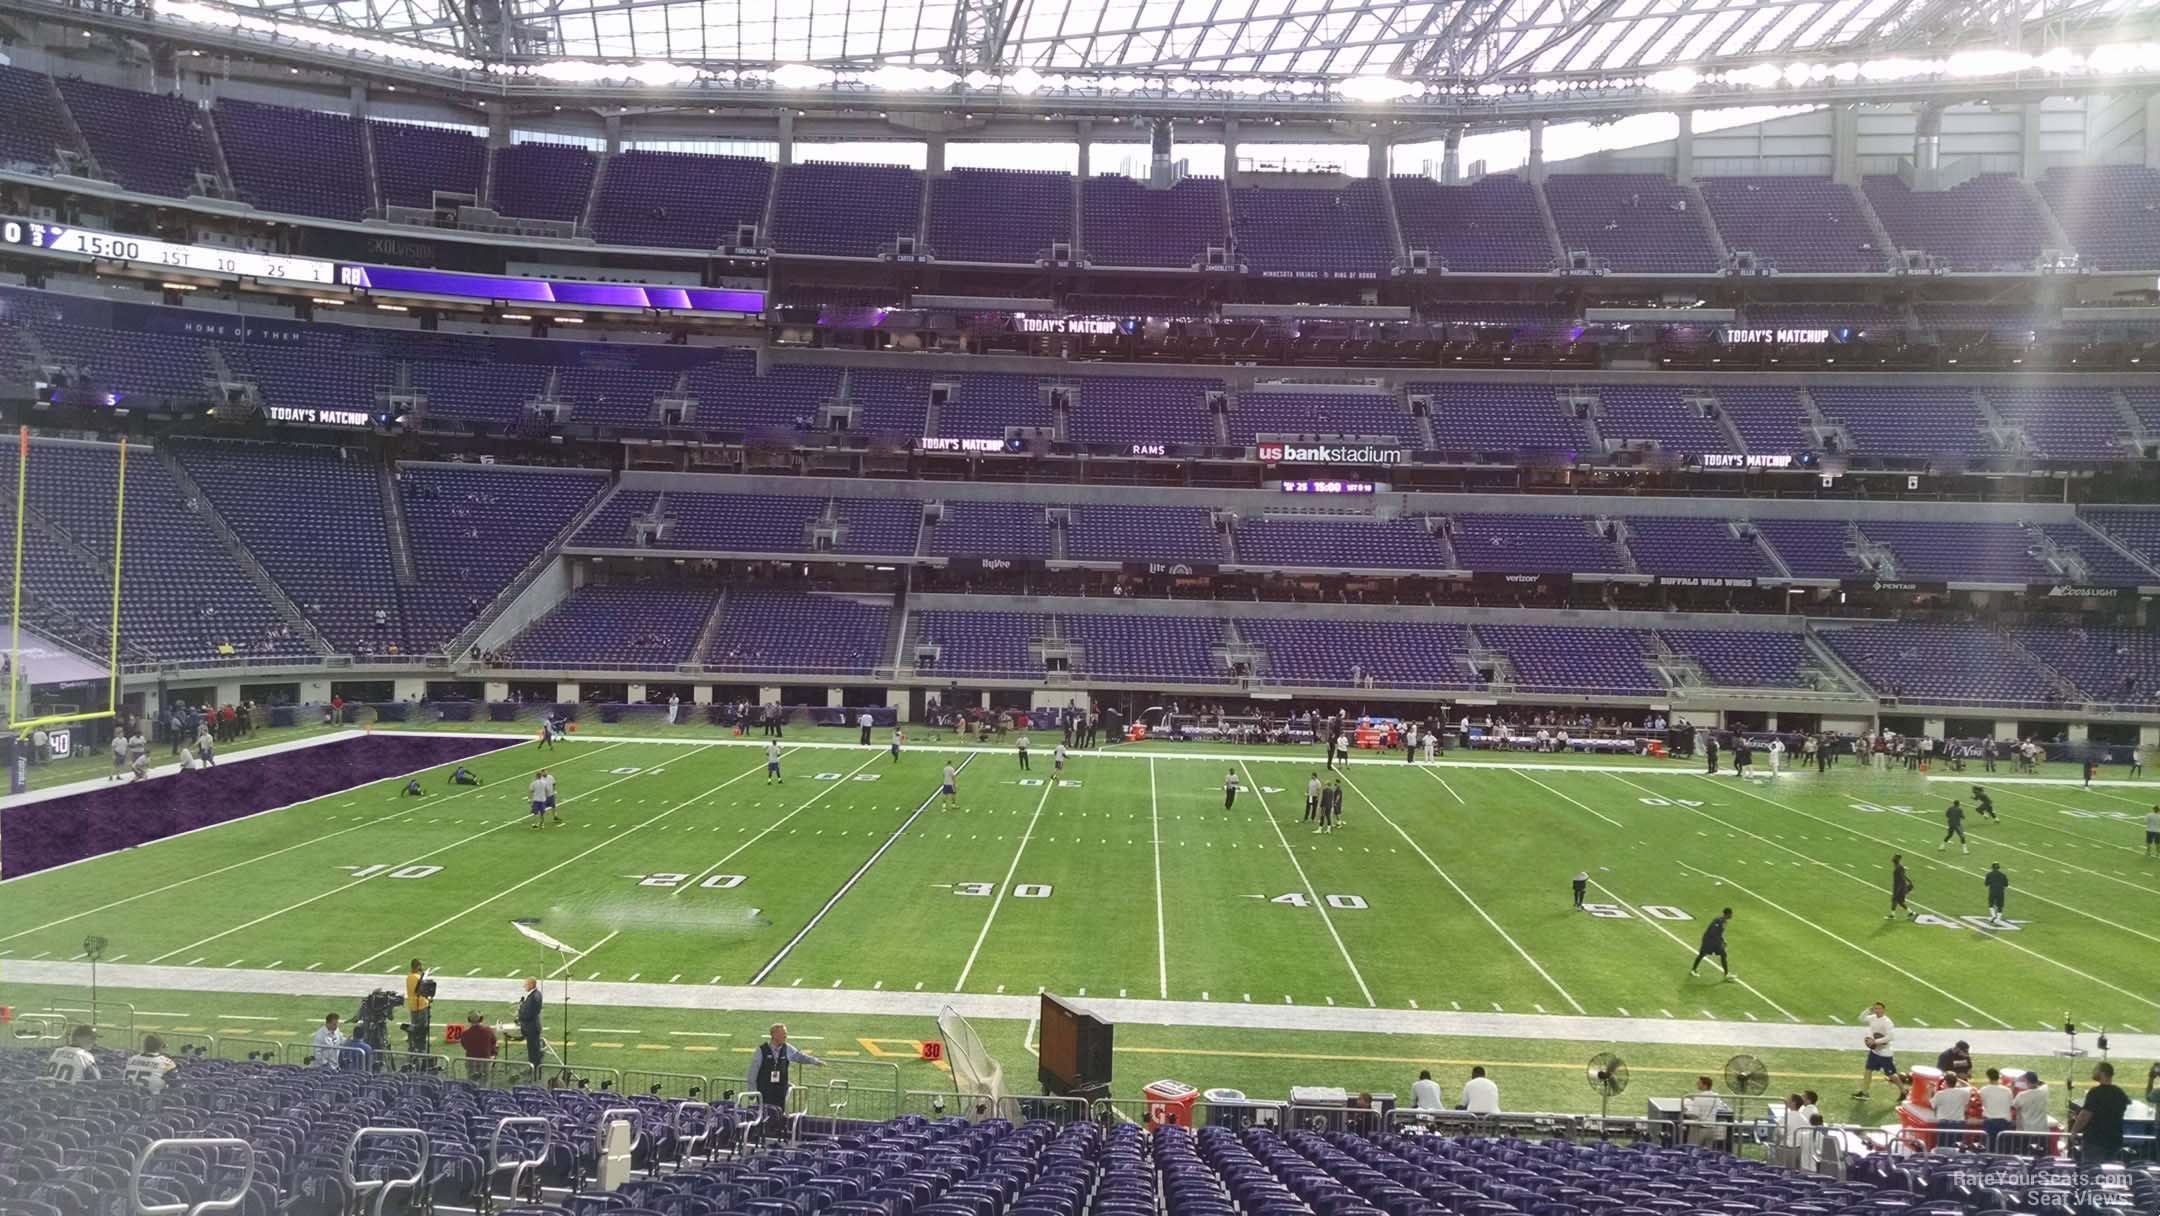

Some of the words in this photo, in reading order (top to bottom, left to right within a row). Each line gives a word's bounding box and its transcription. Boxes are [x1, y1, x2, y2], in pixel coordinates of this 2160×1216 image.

[5, 223, 21, 243] 0
[32, 232, 43, 247] 3
[77, 235, 139, 259] 15:00
[162, 252, 190, 265] 1ST
[218, 258, 235, 272] 10
[267, 264, 286, 278] 25
[185, 323, 225, 336] HOME
[1023, 318, 1066, 333] TODAY'S
[1068, 320, 1117, 335] MATCHUP
[1727, 329, 1773, 343] TODAY'S
[1776, 329, 1830, 343] MATCHUP
[270, 406, 316, 422] TODAY'S
[320, 410, 369, 425] MATCHUP
[922, 437, 960, 451] TODAY'S
[962, 438, 1005, 451] MATCHUP
[1132, 444, 1166, 456] RAMS
[1703, 454, 1743, 467] TODAY'S
[1747, 455, 1792, 468] MATCHUP
[1505, 574, 1537, 583] verizon
[1660, 577, 1698, 586] BUFFALO
[1701, 577, 1723, 586] WILD
[1725, 578, 1753, 587] WINGS
[1882, 583, 1916, 591] PENTAIR
[49, 734, 69, 754] 40
[950, 882, 1054, 899] 30
[1268, 893, 1371, 910] 40
[924, 1043, 941, 1058] 30
